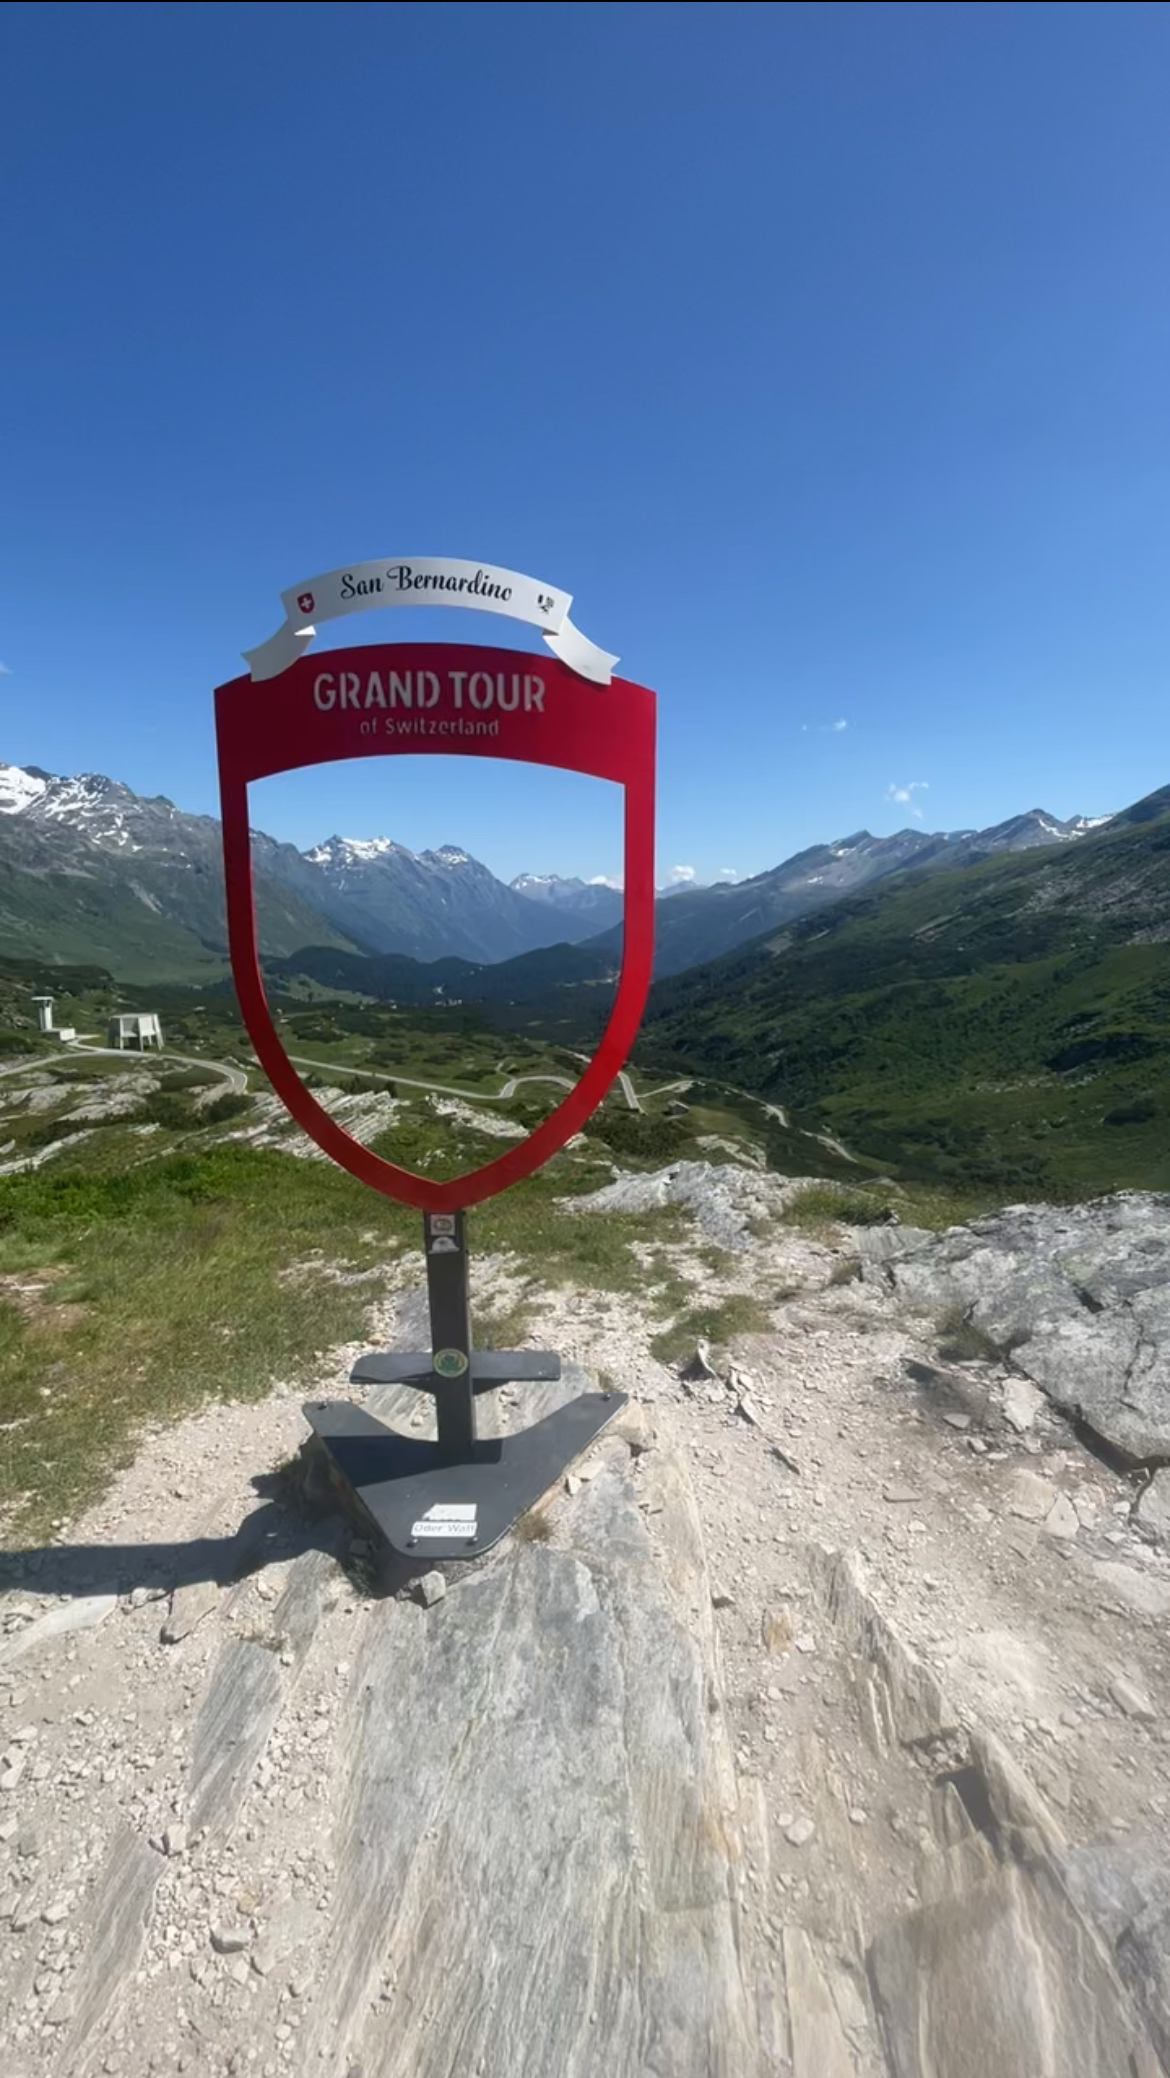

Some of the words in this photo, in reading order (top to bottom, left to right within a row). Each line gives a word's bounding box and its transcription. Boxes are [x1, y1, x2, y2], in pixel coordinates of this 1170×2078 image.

[341, 573, 384, 600] San
[386, 565, 513, 602] Bernardino
[313, 670, 441, 711] GRAND
[448, 671, 546, 713] TOUR
[360, 717, 378, 735] of
[386, 716, 499, 736] Switzerland
